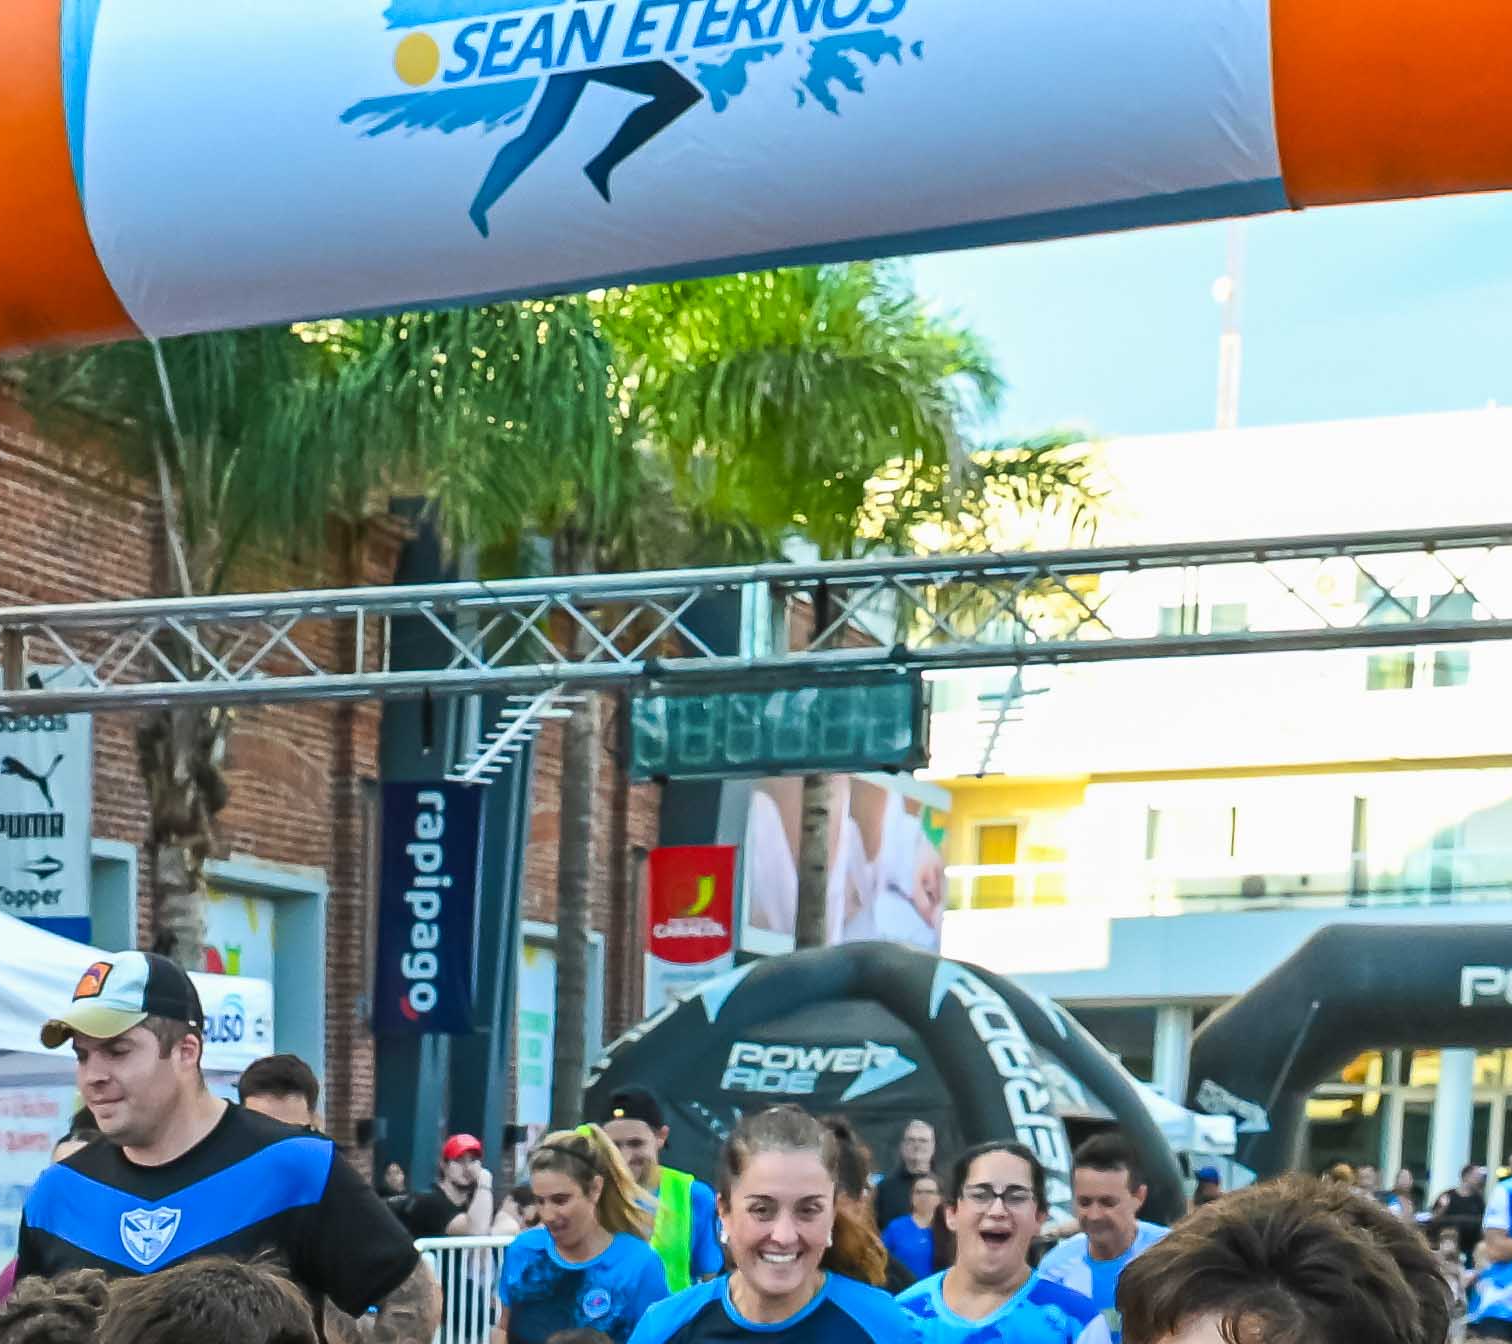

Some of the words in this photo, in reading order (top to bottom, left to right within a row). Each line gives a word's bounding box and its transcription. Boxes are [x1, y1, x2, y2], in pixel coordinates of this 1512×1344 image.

[443, 4, 615, 83] SEAN
[401, 790, 453, 1013] rapipago
[726, 1041, 898, 1074] POWER
